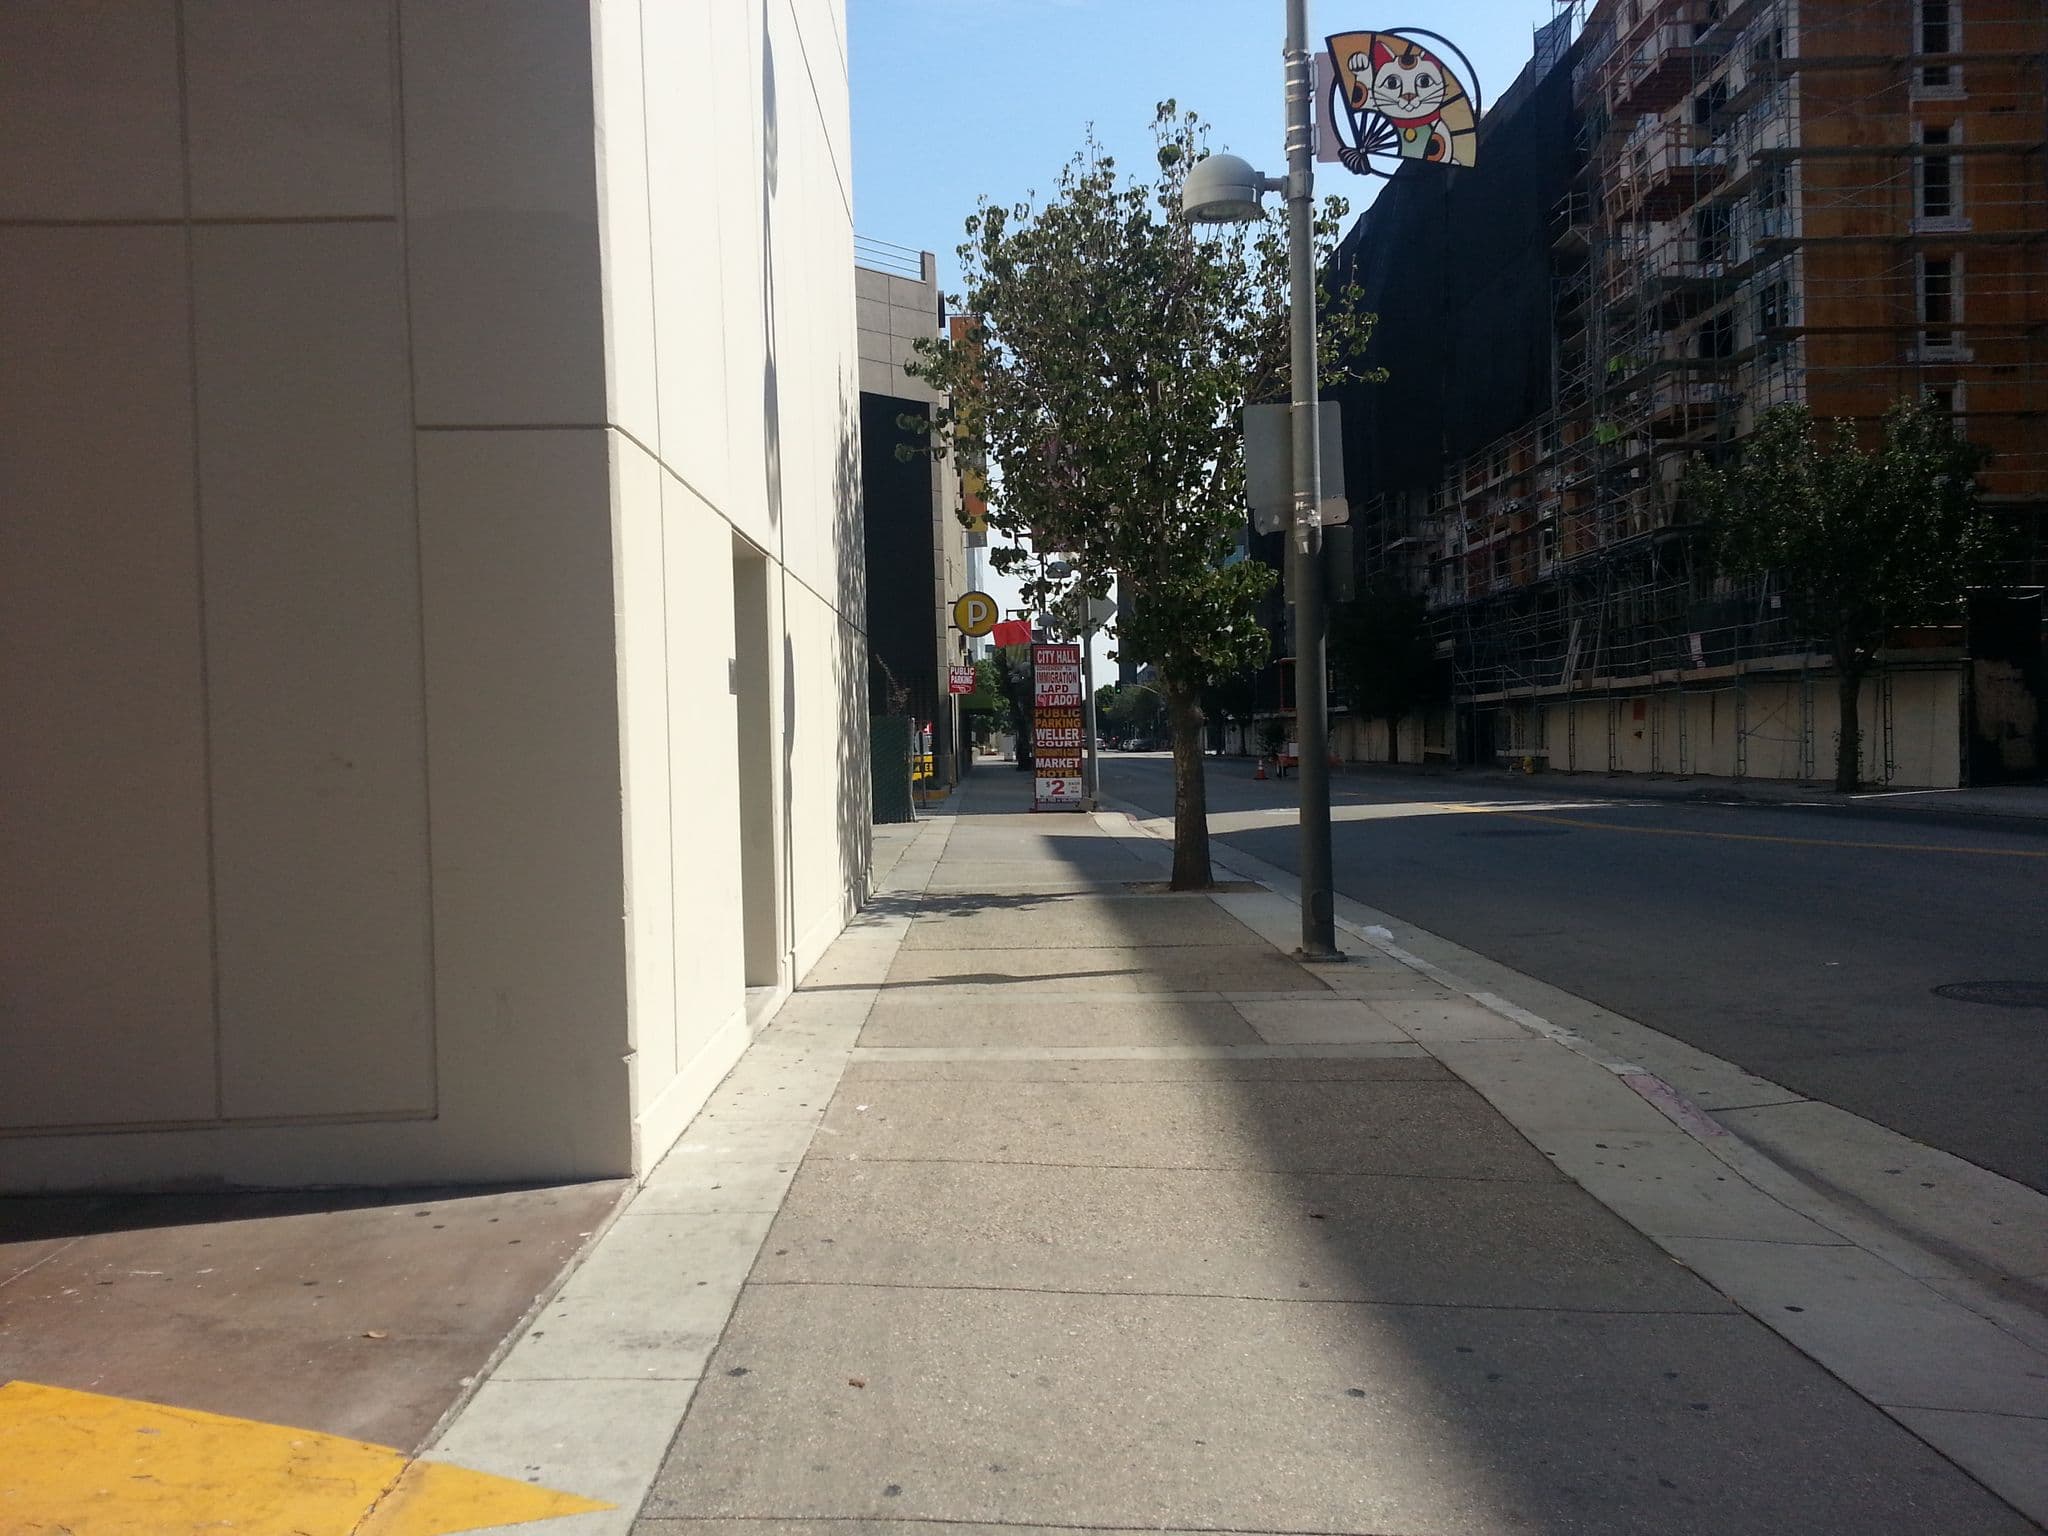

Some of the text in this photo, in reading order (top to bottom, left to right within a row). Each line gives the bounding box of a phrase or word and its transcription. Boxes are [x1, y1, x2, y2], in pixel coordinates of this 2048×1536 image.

[967, 600, 988, 628] P
[1037, 650, 1076, 663] CITY HALL
[950, 667, 975, 675] PUBLIC
[950, 675, 973, 684] PARKING
[1036, 672, 1077, 683] IMMIGRATION
[1041, 684, 1069, 693] LAPD
[1048, 695, 1079, 706] LADOT
[1035, 709, 1080, 718] PUBLIC
[1035, 718, 1081, 728] PARKING
[1035, 728, 1079, 740] WELLER
[1035, 758, 1080, 768] MARKET
[1037, 769, 1081, 777] HOTEL
